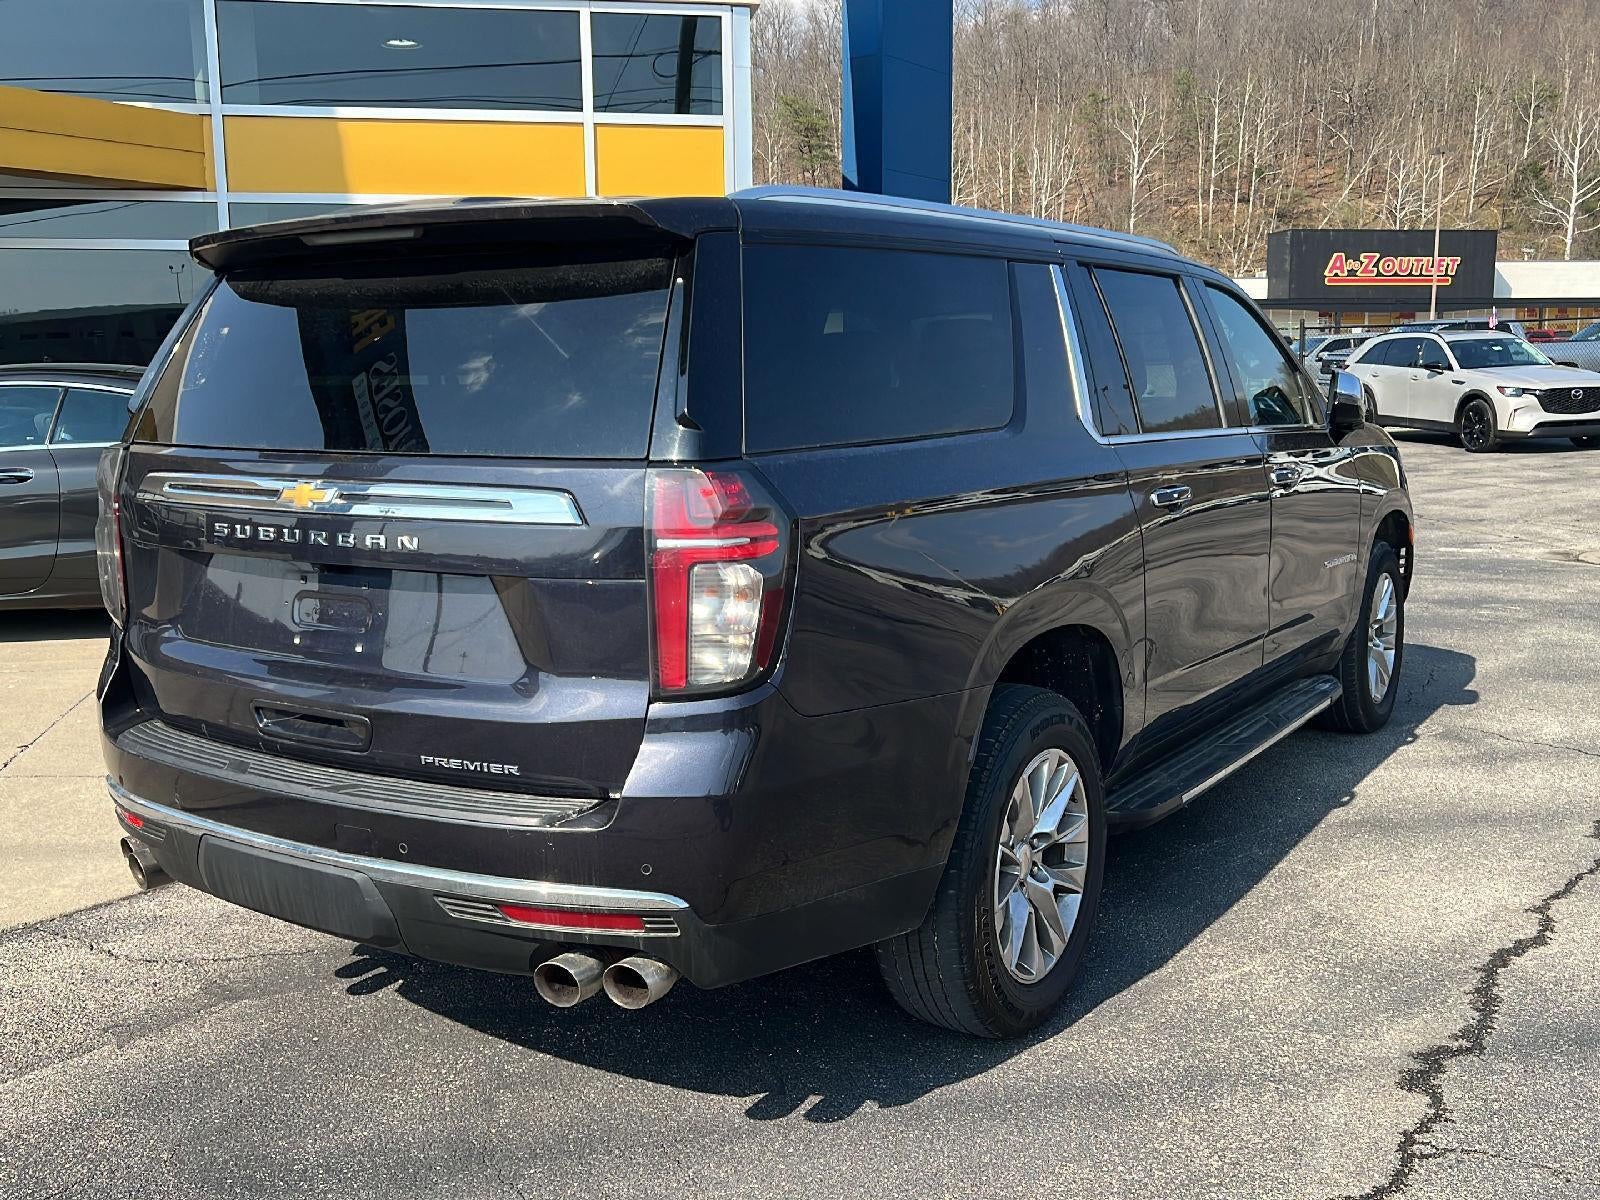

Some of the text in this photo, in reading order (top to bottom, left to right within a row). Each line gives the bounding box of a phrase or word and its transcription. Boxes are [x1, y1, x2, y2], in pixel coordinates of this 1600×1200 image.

[1379, 256, 1461, 276] OUTLET
[214, 522, 420, 551] SUBURBAN
[420, 755, 520, 776] PREMIER
